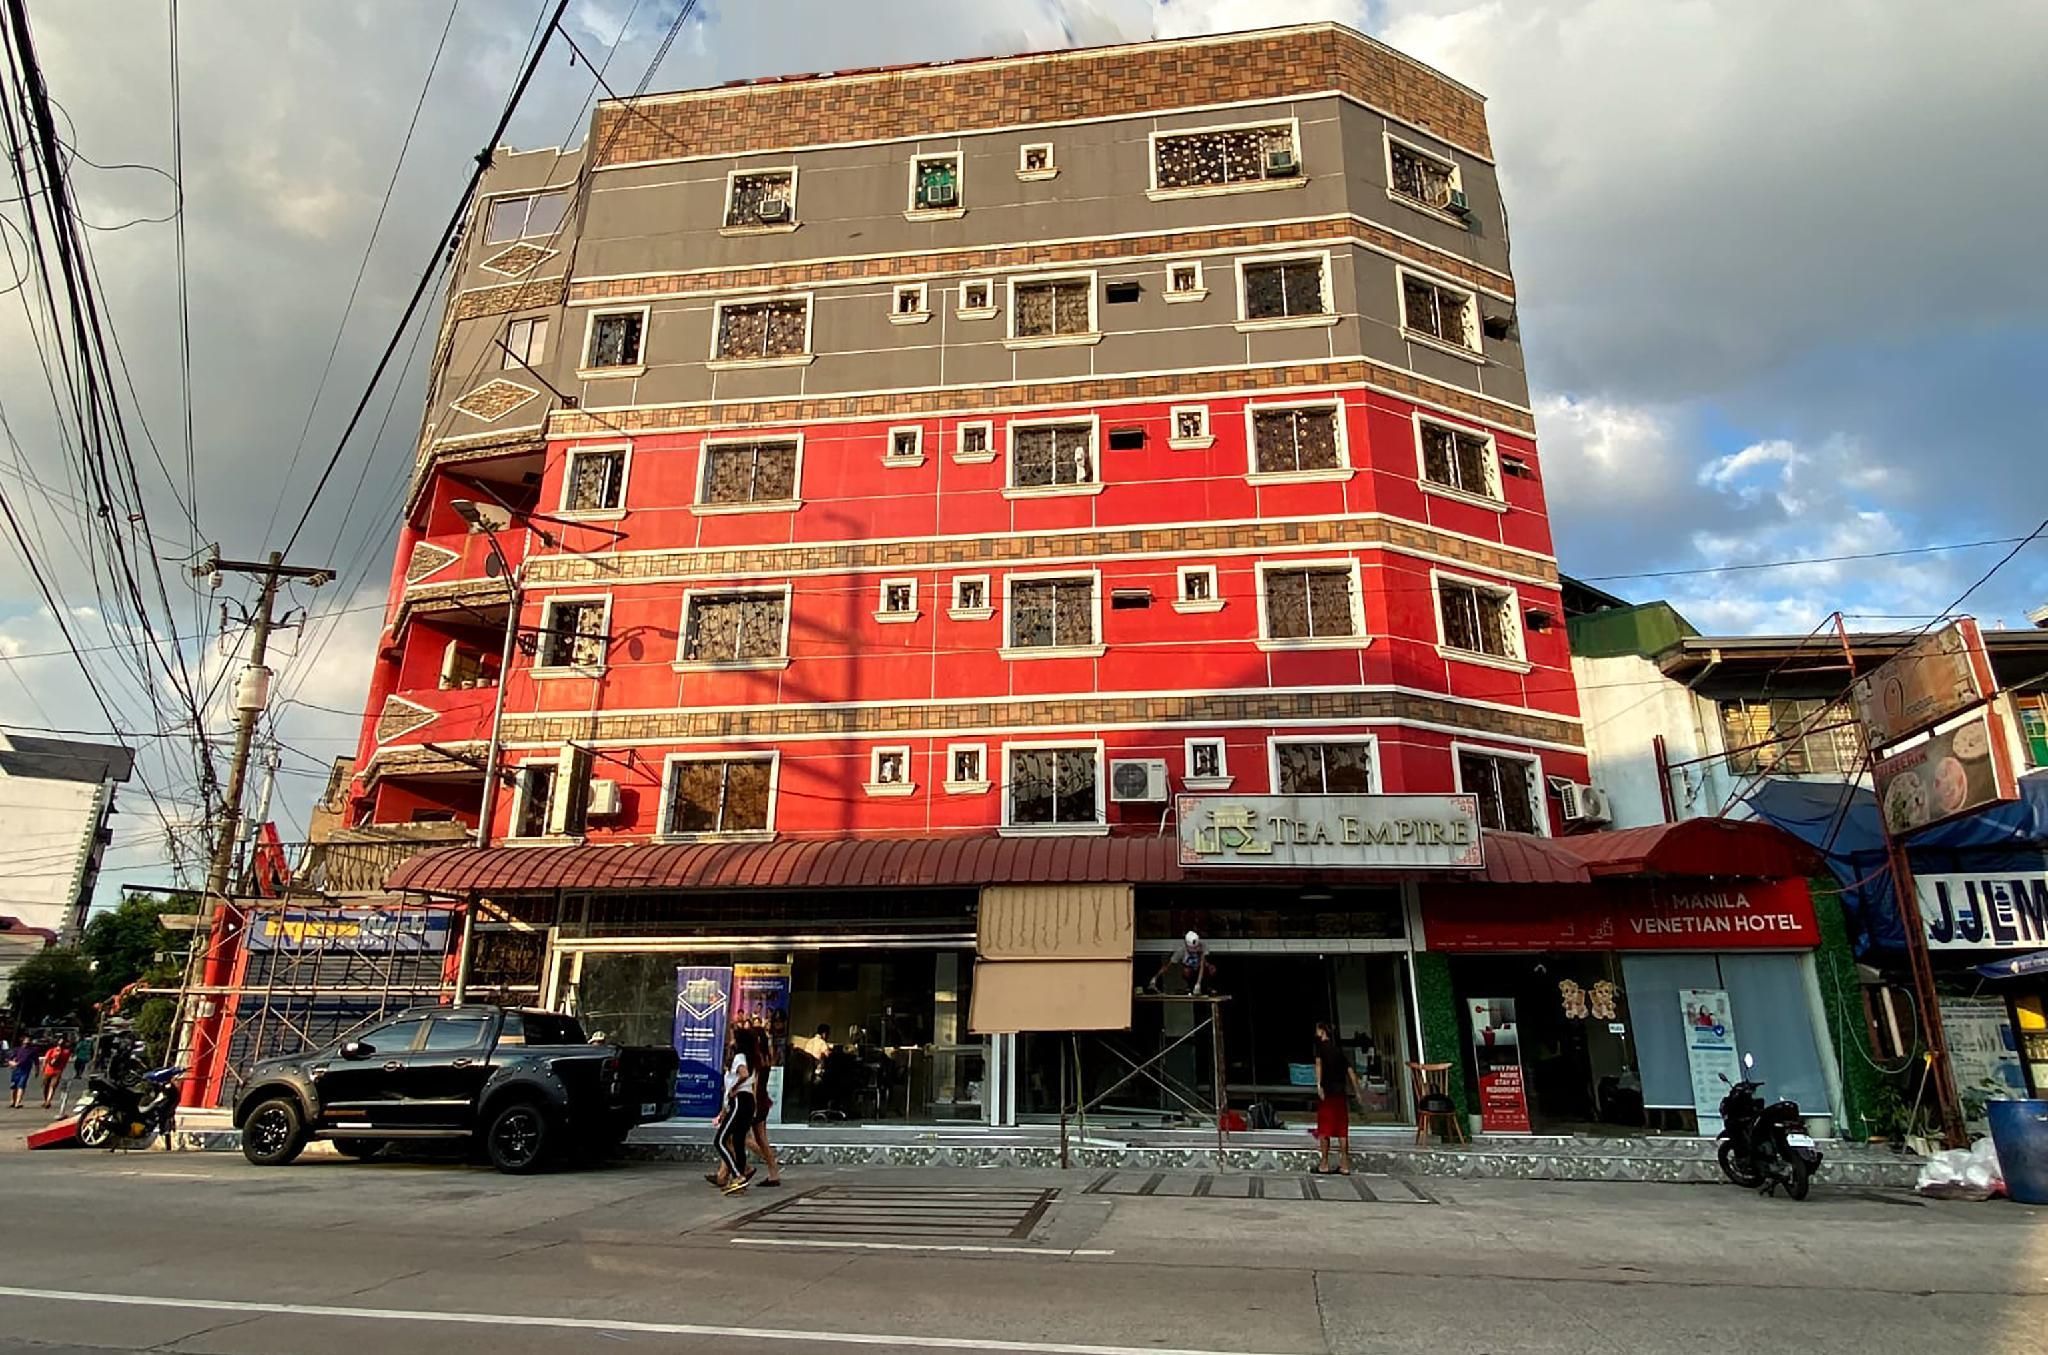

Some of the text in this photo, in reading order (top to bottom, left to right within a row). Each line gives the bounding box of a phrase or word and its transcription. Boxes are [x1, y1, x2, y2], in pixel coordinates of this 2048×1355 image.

[1267, 815, 1472, 846] TEA EMPIRE
[1672, 892, 1751, 909] MANILA
[1630, 914, 1803, 934] VENETIAN HOTEL
